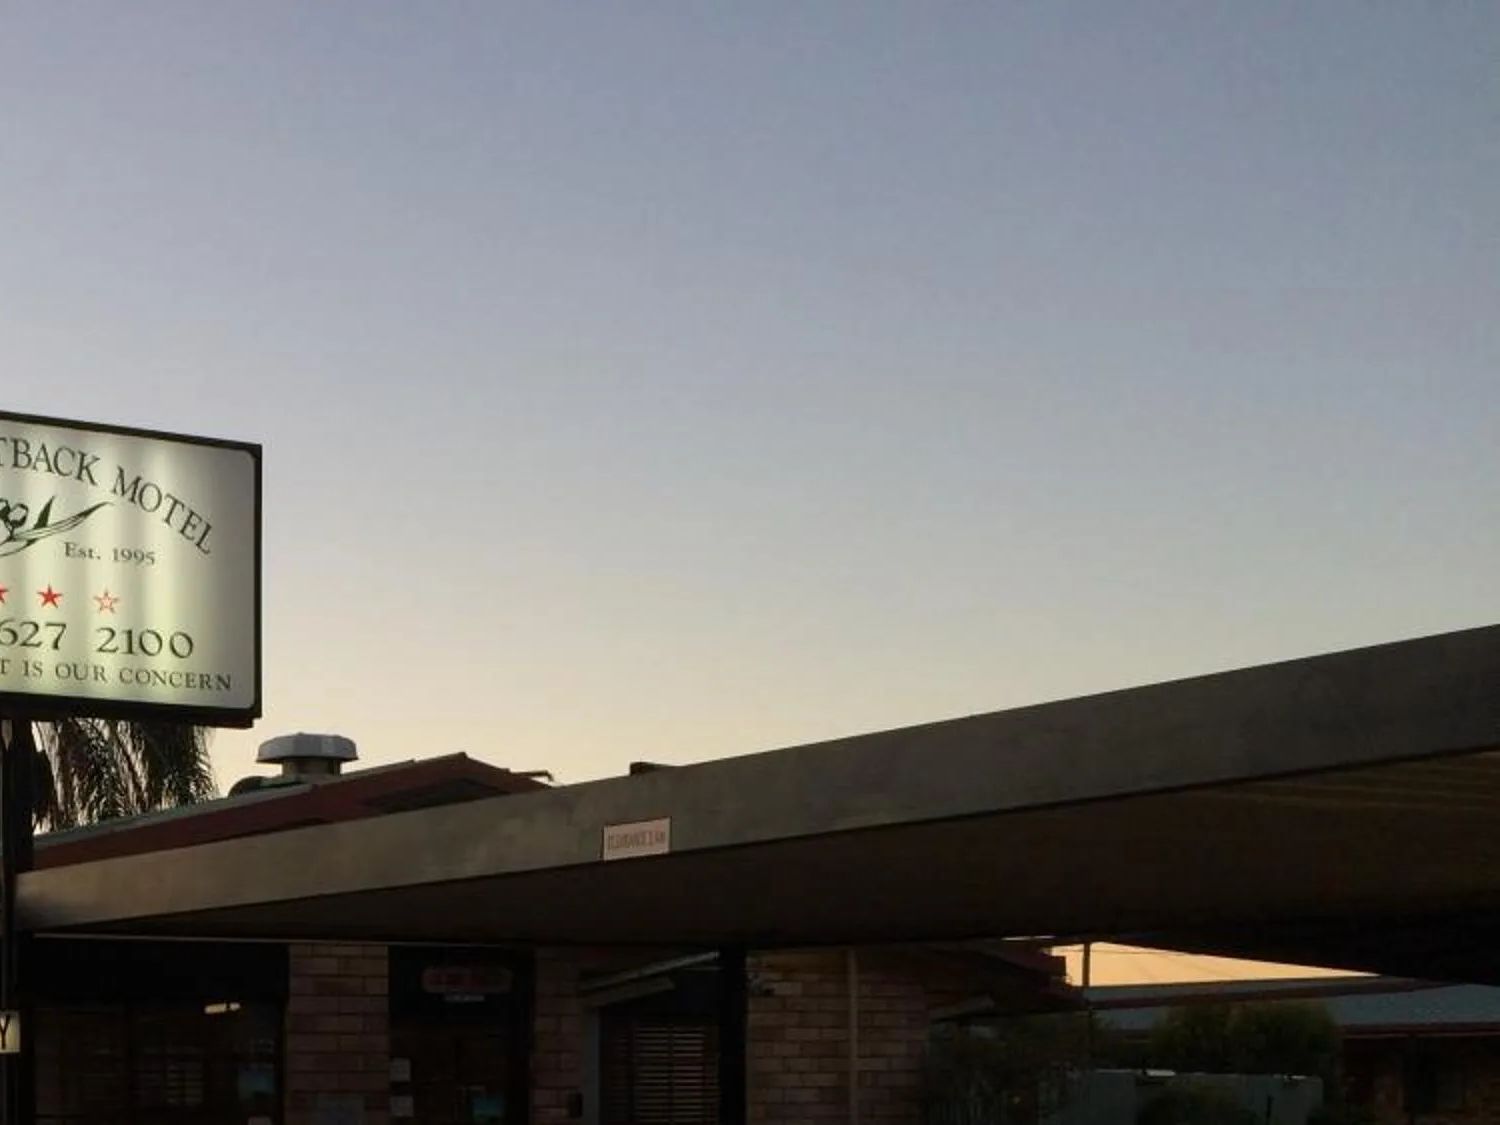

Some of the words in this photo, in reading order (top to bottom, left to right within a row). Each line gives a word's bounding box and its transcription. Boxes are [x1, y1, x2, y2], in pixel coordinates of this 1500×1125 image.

[111, 466, 214, 556] MOTEL
[64, 541, 101, 562] Est.
[112, 547, 156, 566] 1995
[95, 626, 195, 660] 2100
[22, 658, 44, 678] IS
[55, 662, 109, 683] OUR
[118, 666, 233, 692] CONCERN
